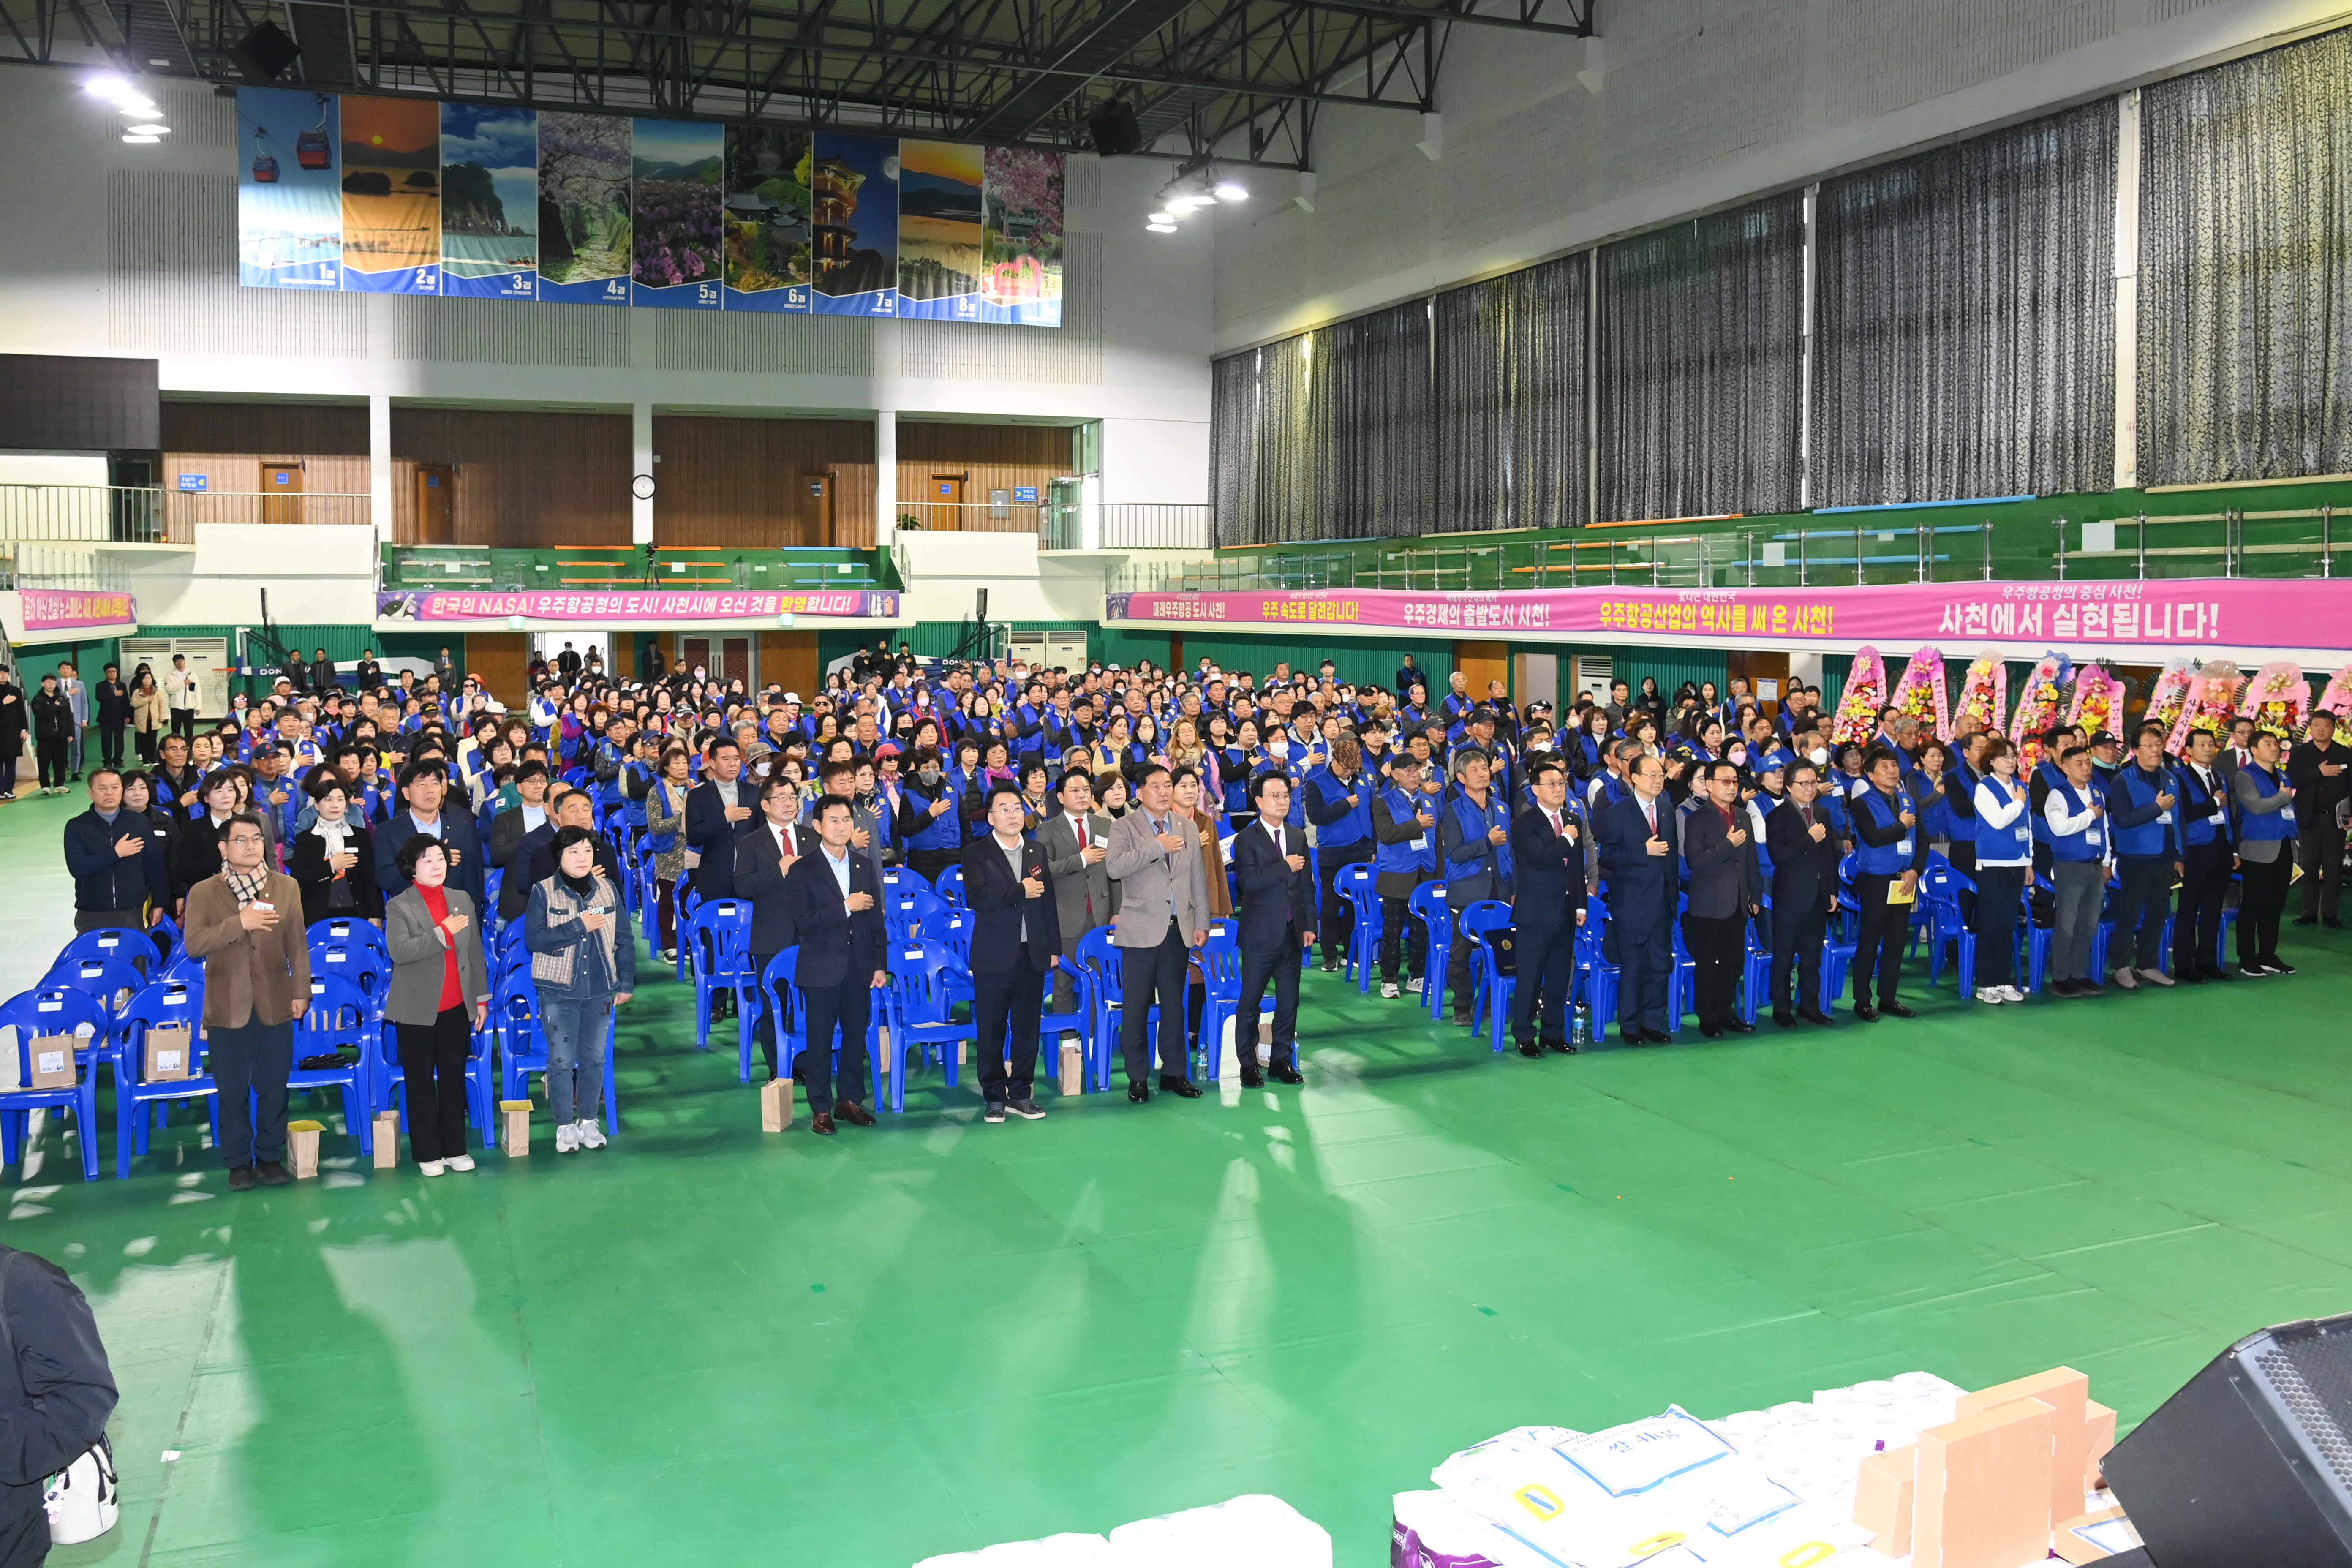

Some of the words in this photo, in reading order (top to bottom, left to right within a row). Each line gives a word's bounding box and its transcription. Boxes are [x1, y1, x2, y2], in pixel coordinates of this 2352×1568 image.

[1677, 591, 1701, 602] 빛나는
[1703, 591, 1737, 602] 대한민국
[2001, 585, 2077, 600] 우주항공청의
[2080, 585, 2107, 600] 중심
[2109, 584, 2143, 599] 사천!
[432, 596, 474, 614] 한국의
[478, 597, 535, 614] NASA!
[537, 597, 623, 613] 우주항공청의
[625, 597, 659, 613] 도시!
[661, 597, 717, 613] 사천시에
[719, 597, 747, 612] 오신
[750, 596, 777, 612] 것을
[780, 596, 852, 613] 환영합니다!
[1153, 600, 1192, 618] 미래우주항공
[1193, 602, 1207, 618] 도시
[1208, 602, 1225, 618] 사천!
[1262, 601, 1279, 618] 우주
[1280, 601, 1306, 619] 속도로
[1309, 601, 1358, 621] 달려갑니다!
[1403, 603, 1460, 626] 우주경제의
[1463, 604, 1514, 627] 출발도시
[1518, 604, 1550, 627] 사천!
[1599, 602, 1697, 631] 우주항공산업의
[1701, 604, 1746, 632] 역사를
[1751, 605, 1767, 632] 써
[1771, 604, 1787, 633] 온
[1792, 604, 1834, 634] 사천!
[1938, 602, 2042, 636] 사천에서
[2053, 603, 2219, 639] 실현됩니다!
[1636, 1429, 1680, 1443] 4kg
